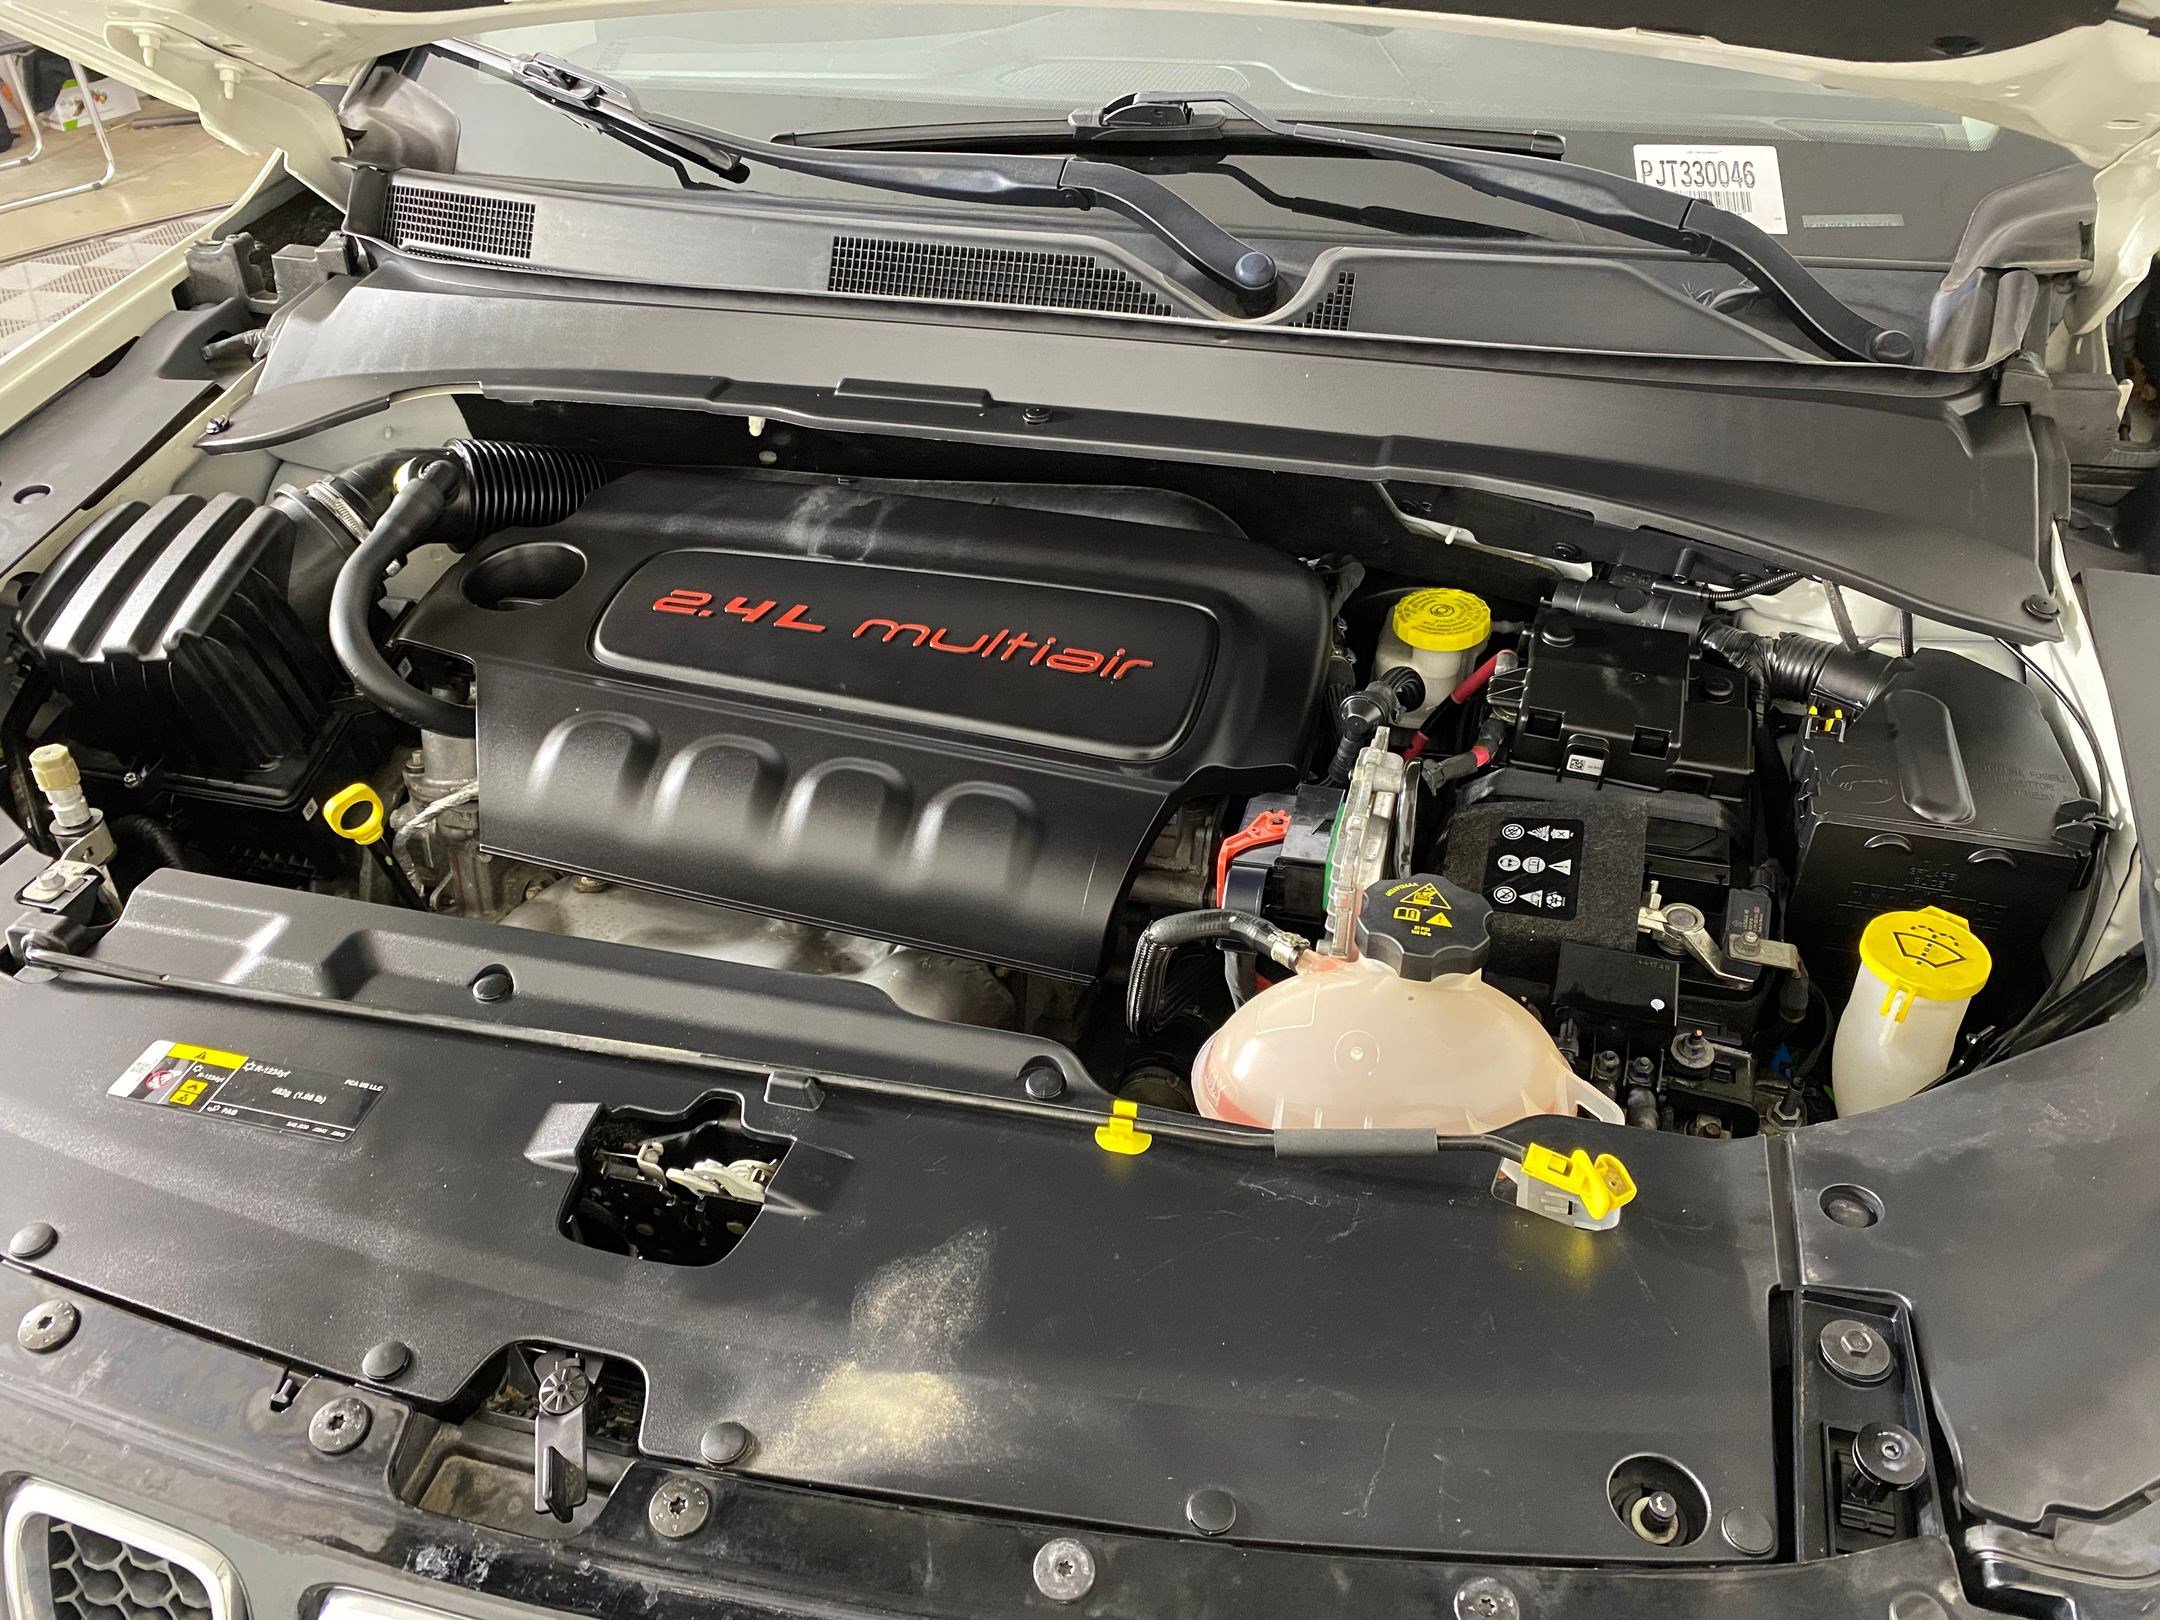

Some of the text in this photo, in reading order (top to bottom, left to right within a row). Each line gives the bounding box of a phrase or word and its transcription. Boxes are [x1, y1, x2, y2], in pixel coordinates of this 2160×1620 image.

[1641, 159, 1755, 189] PJT330046
[652, 589, 1154, 681] 2.4L multiair
[254, 1064, 292, 1078] R-1234yf
[344, 1079, 359, 1087] FCA
[368, 1084, 384, 1092] LLC
